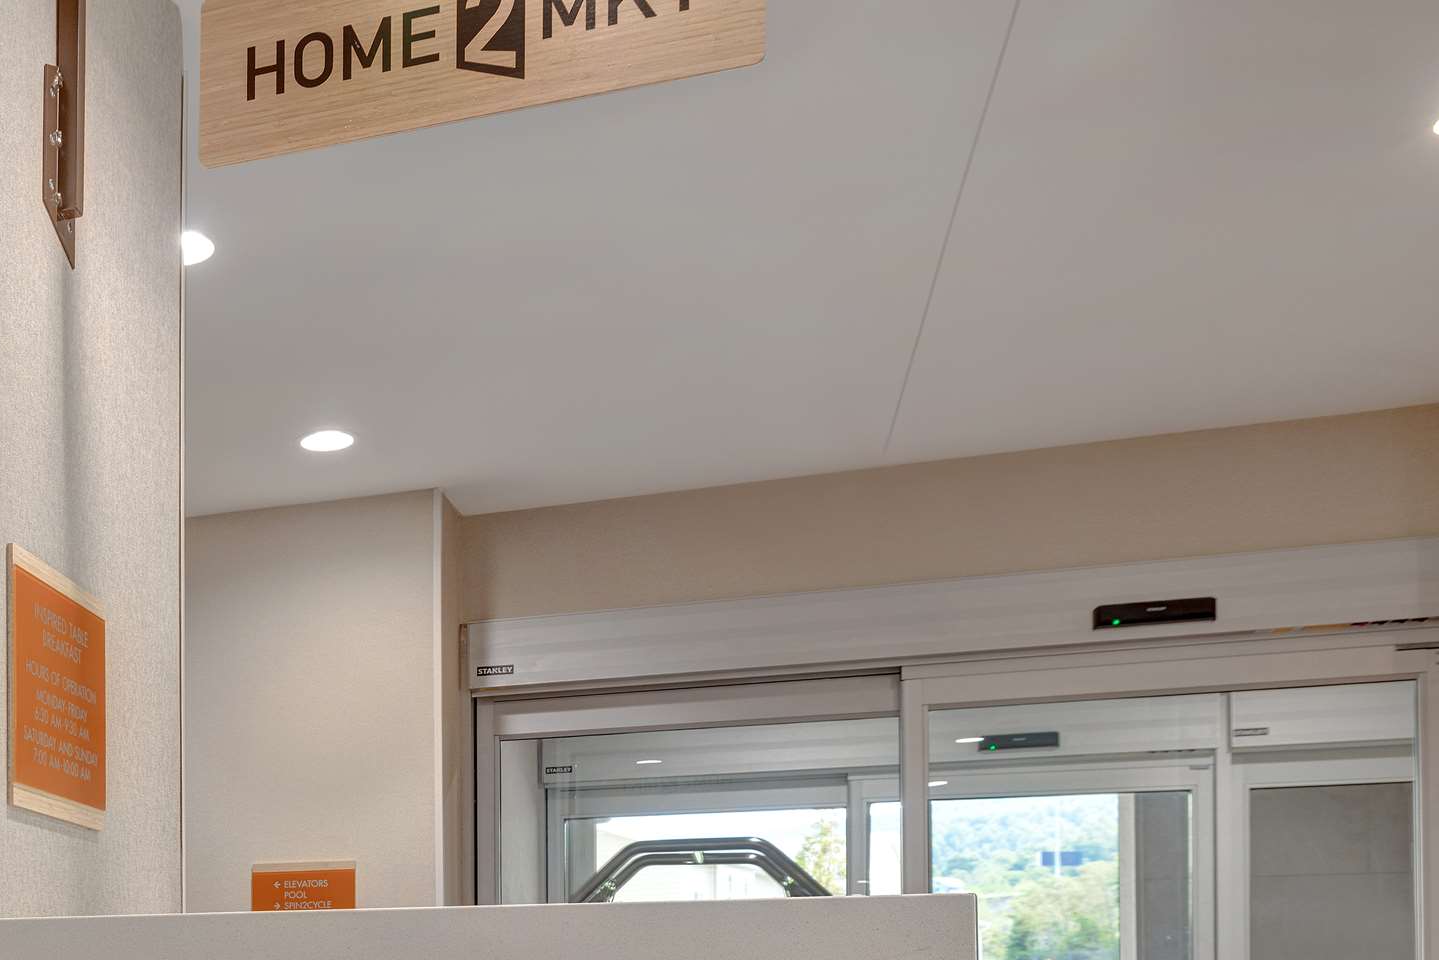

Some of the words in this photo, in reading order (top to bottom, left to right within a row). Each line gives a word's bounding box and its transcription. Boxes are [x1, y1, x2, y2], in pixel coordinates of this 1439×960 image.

[246, 5, 441, 102] HOME
[477, 665, 513, 675] STANLEY
[283, 879, 329, 889] ELEVATORS
[283, 890, 308, 899] POOL
